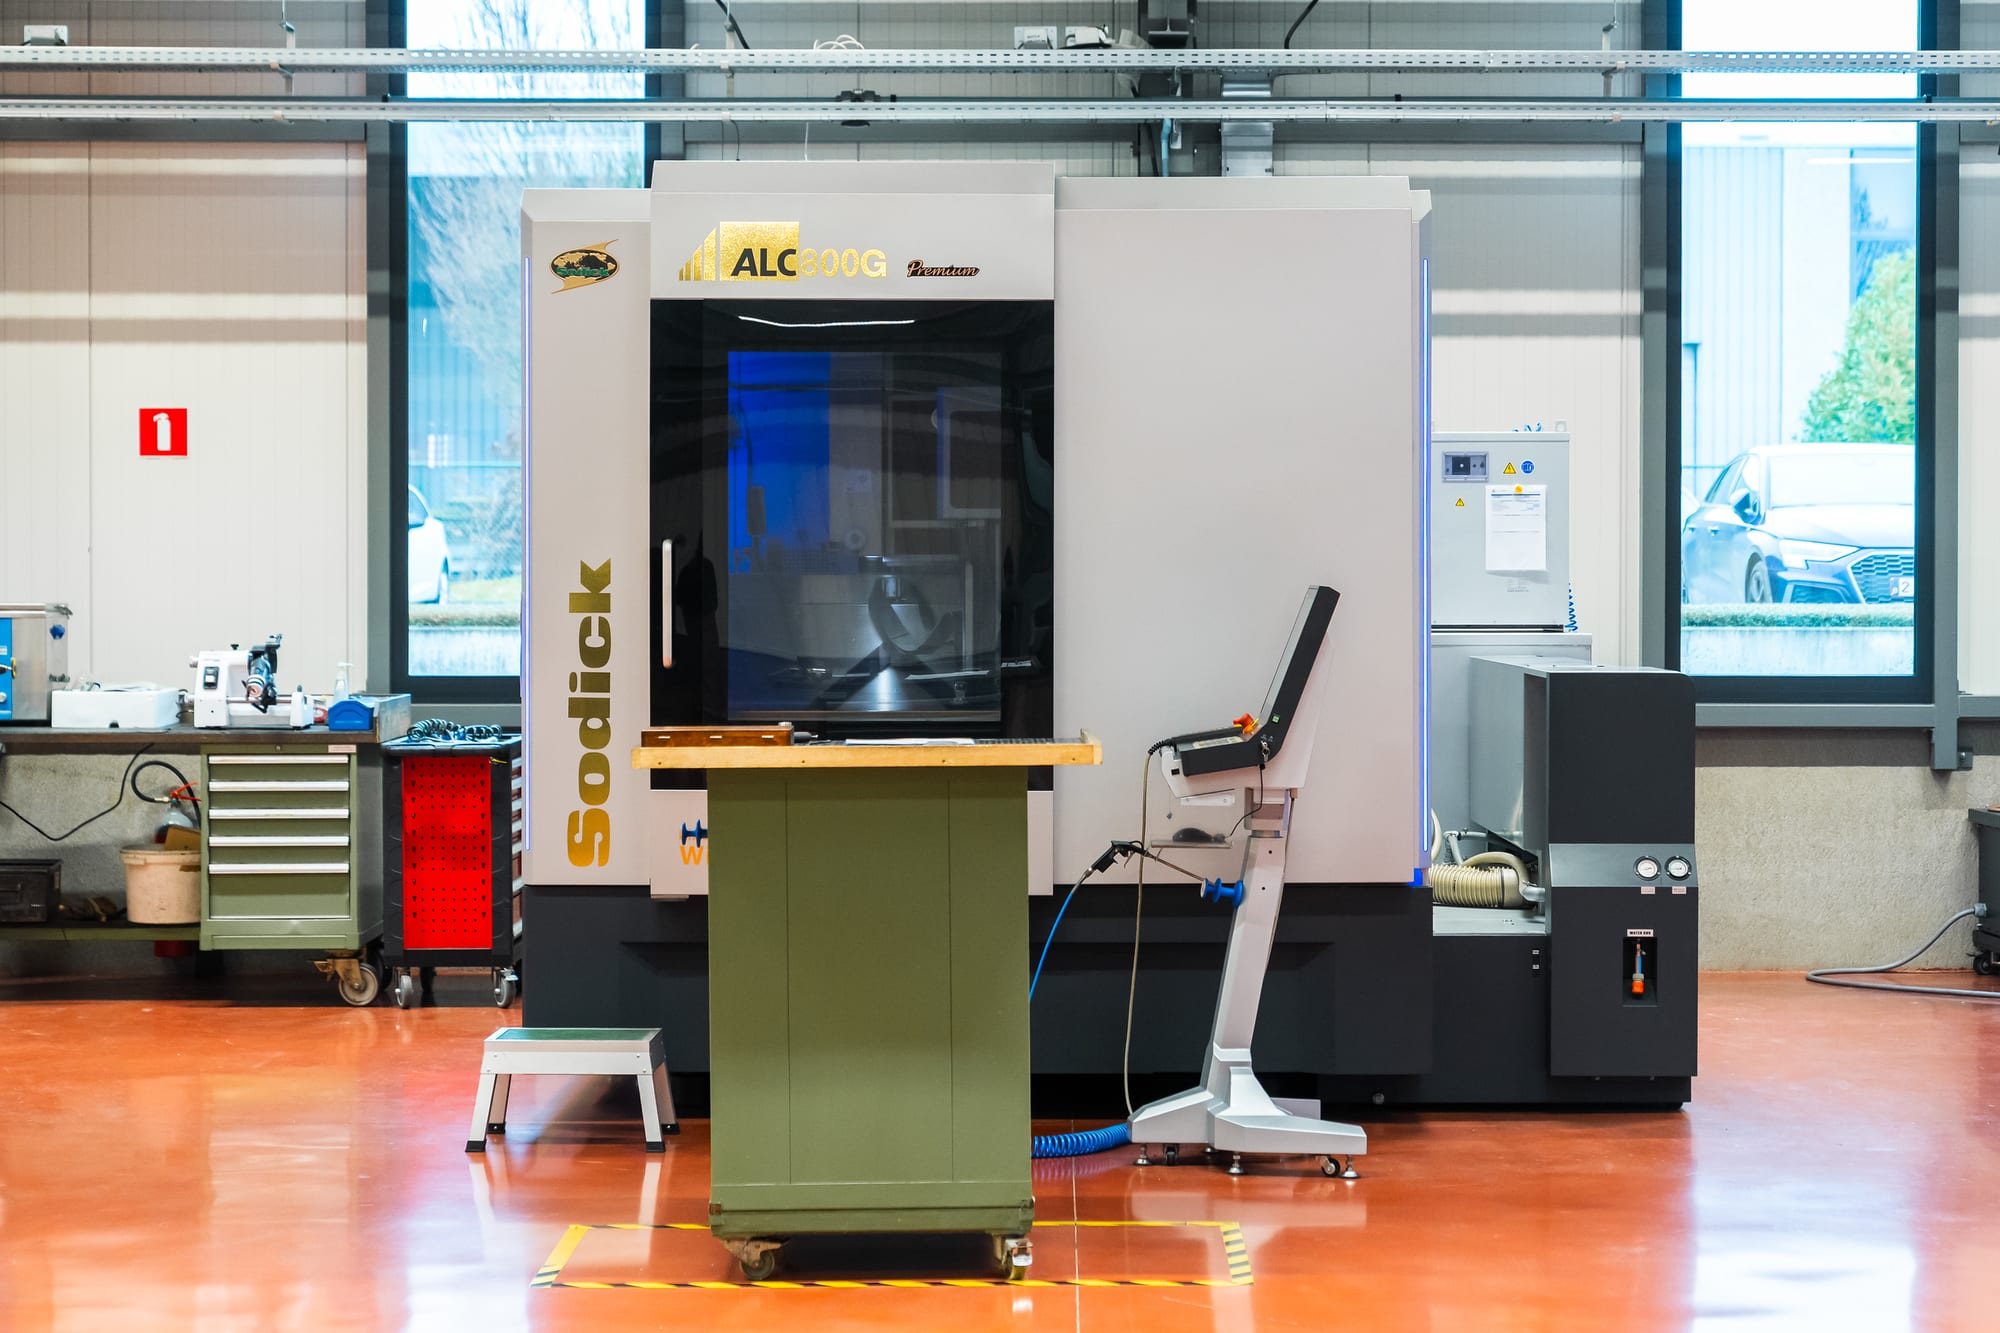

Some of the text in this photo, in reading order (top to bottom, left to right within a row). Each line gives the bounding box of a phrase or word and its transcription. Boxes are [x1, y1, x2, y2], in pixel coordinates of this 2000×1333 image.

[556, 266, 610, 277] Sodick
[731, 247, 887, 278] ALC800G
[907, 259, 980, 277] Premium
[567, 558, 612, 867] Sodick
